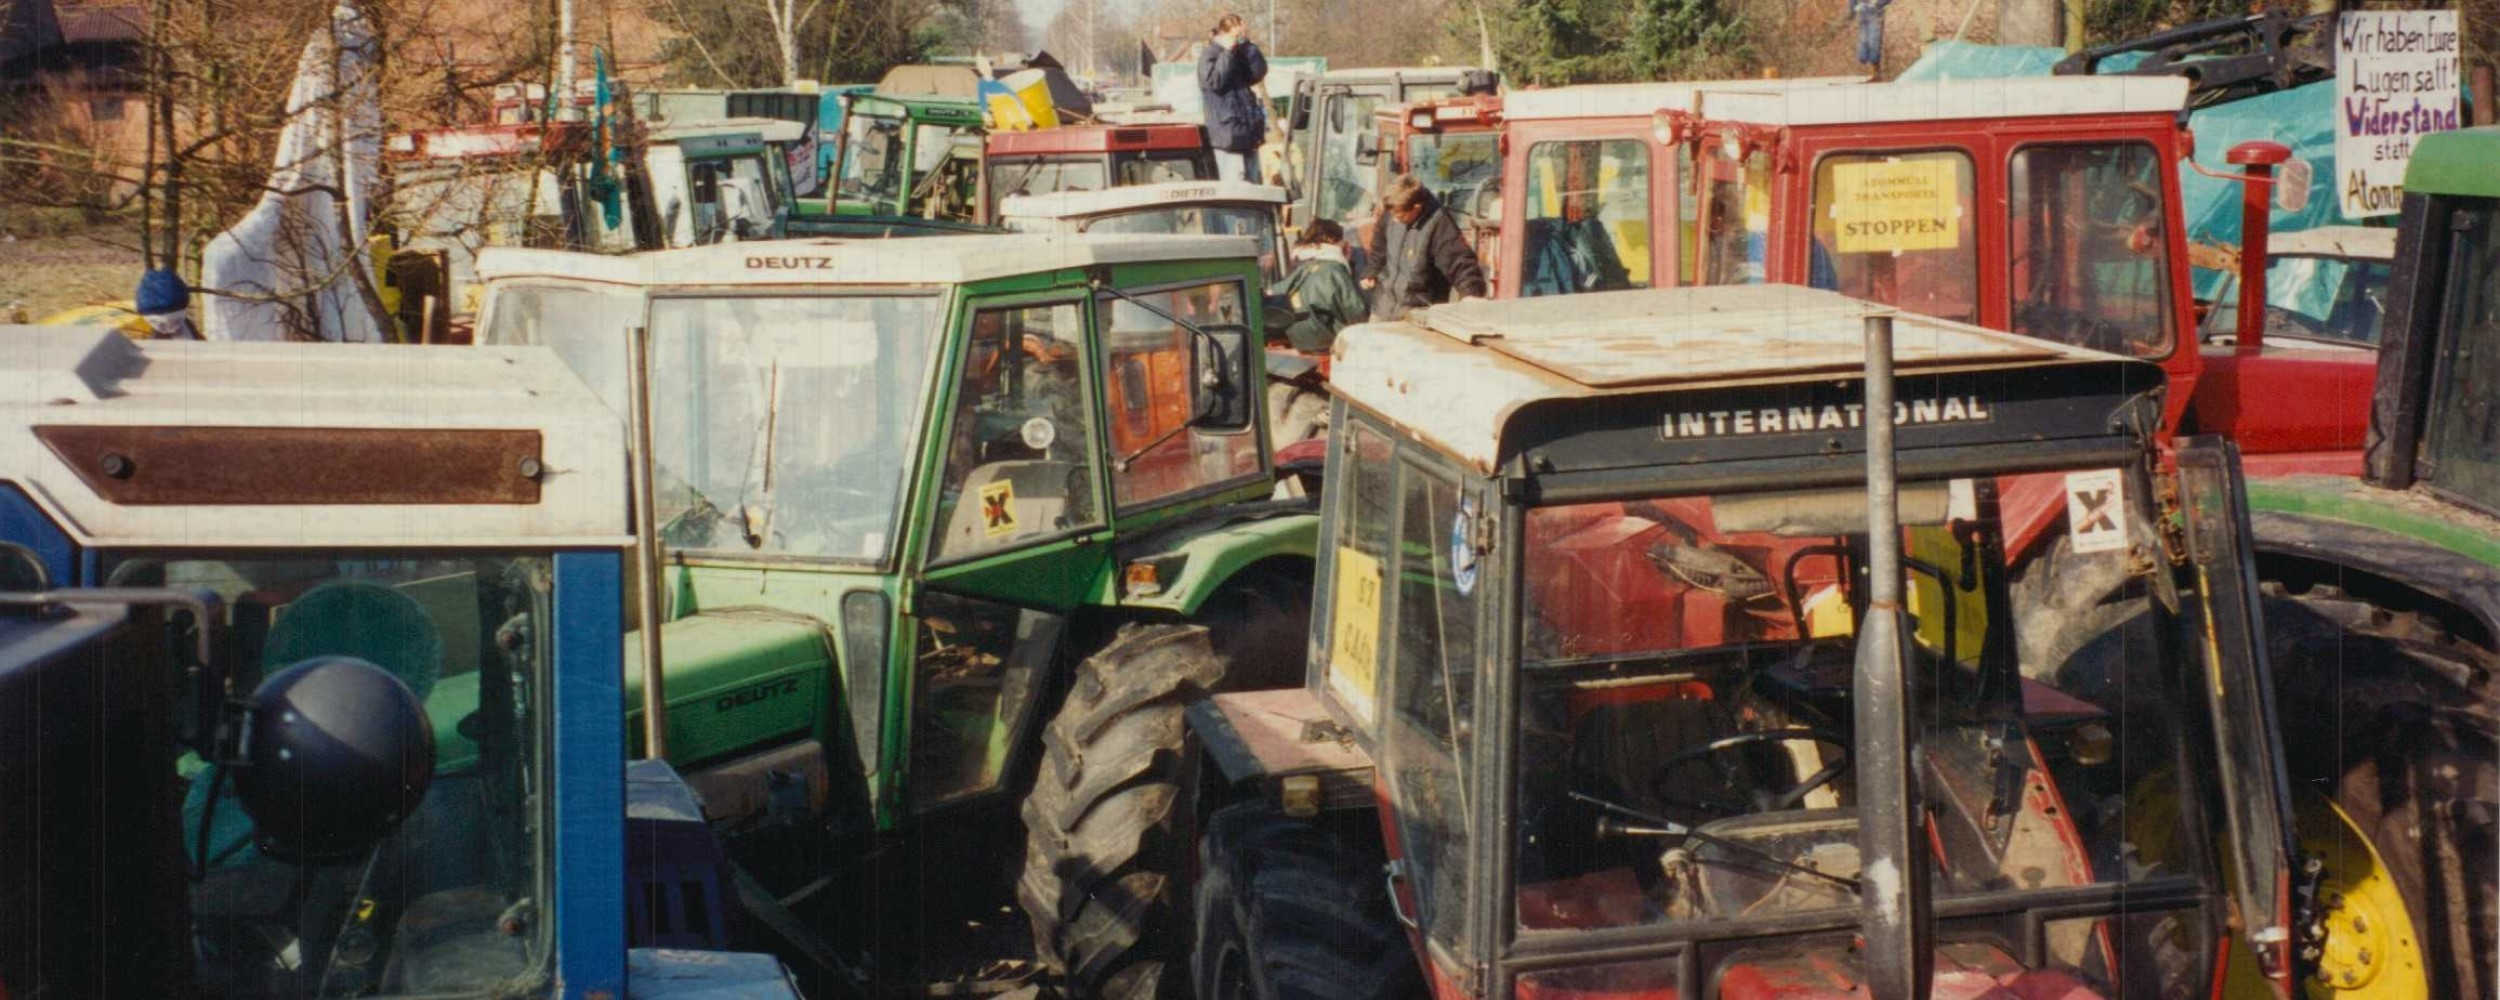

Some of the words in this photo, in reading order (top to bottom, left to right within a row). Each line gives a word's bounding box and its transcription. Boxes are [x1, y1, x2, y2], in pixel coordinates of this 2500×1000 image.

[2341, 16, 2373, 53] Wir
[2377, 16, 2425, 53] haben
[2345, 96, 2458, 136] Widerstand
[1845, 218, 1947, 236] STOPPEN
[745, 256, 834, 269] DEUTZ
[1663, 395, 1988, 438] INTERNATONAL
[716, 676, 800, 712] DEUTZ
